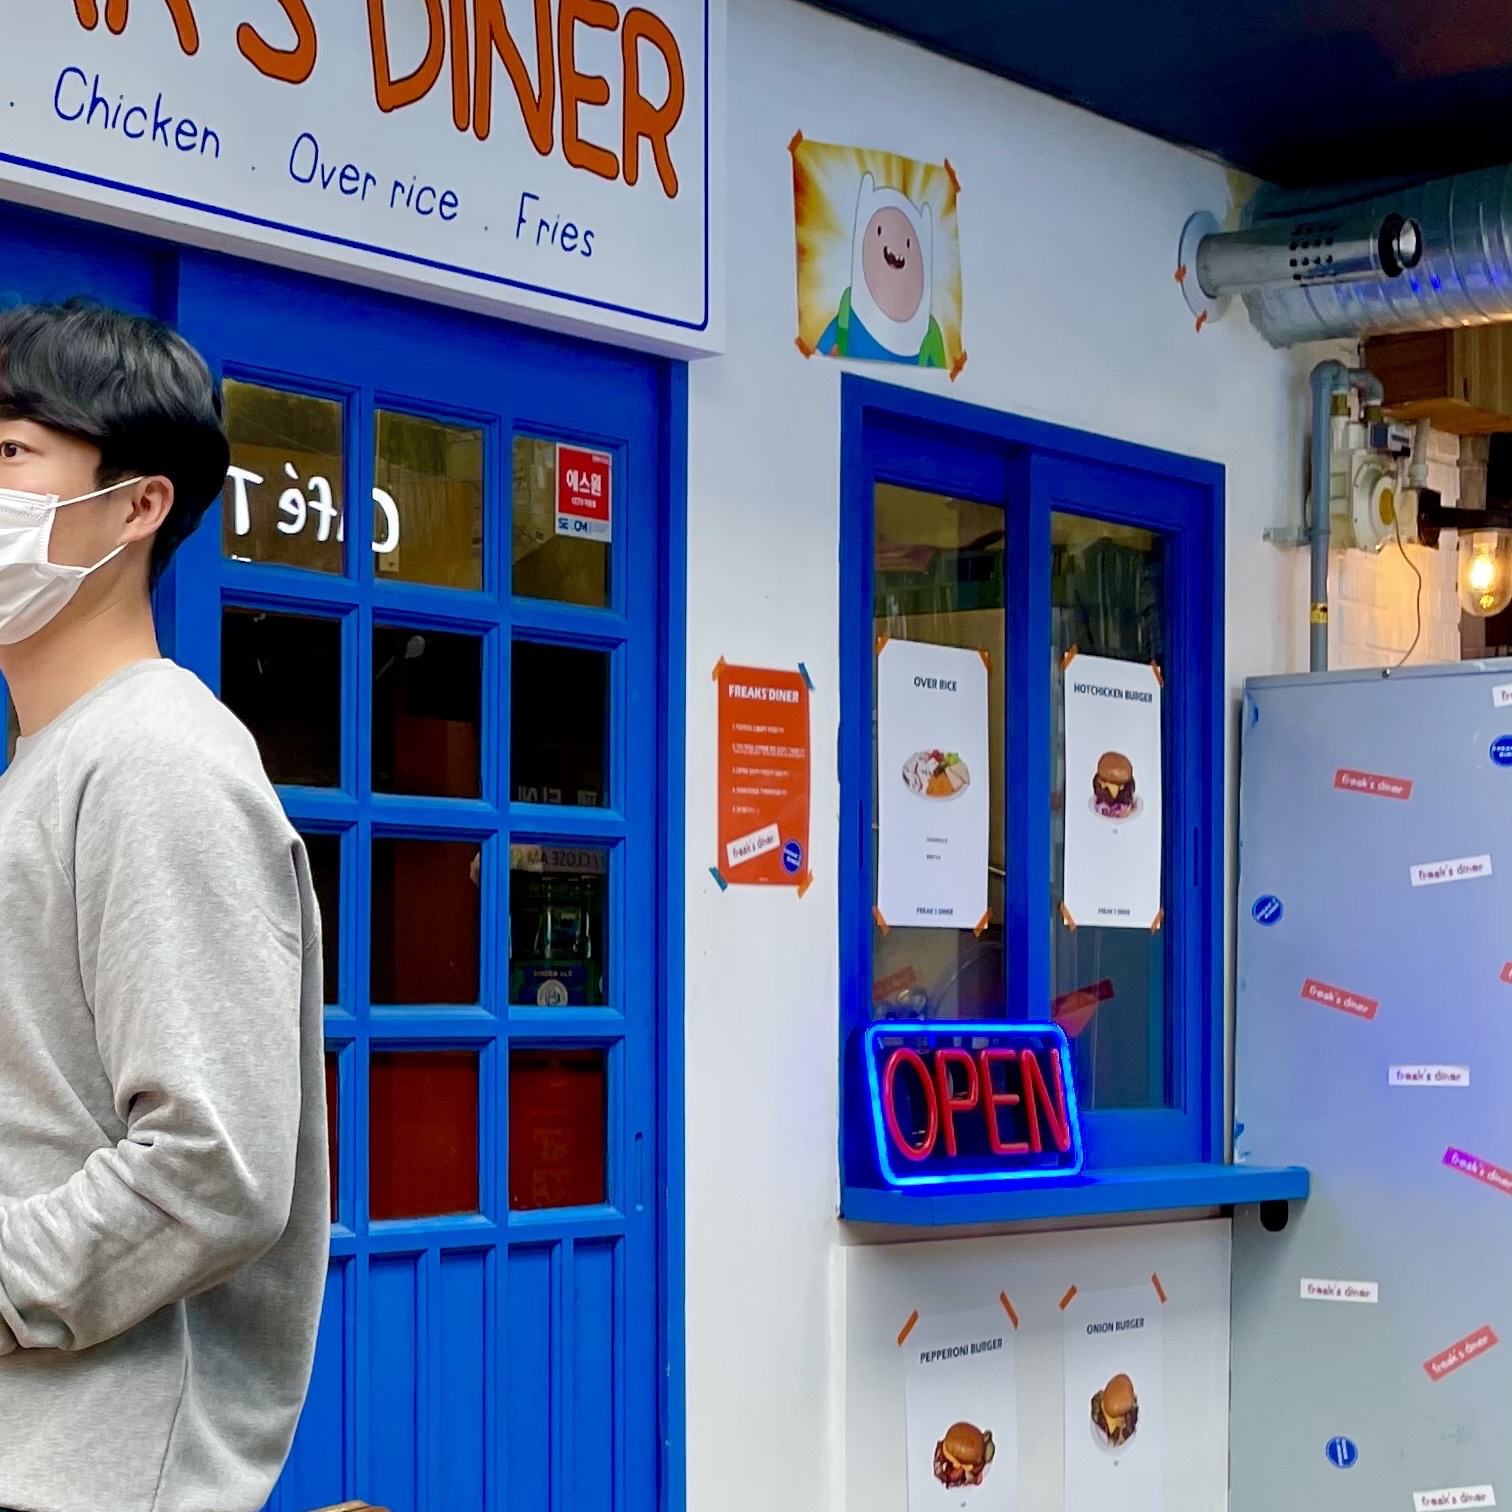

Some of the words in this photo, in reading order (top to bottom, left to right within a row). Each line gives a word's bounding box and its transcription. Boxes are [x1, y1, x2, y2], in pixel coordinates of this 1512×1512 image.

[367, 0, 684, 199] DINER
[54, 66, 221, 159] Chicken
[289, 132, 377, 201] Over
[390, 175, 459, 221] rice
[515, 191, 595, 258] Fries
[769, 687, 800, 704] DINER
[913, 675, 938, 689] OVER
[939, 678, 957, 692] RICE
[883, 1047, 1072, 1162] OPEN
[1086, 1321, 1114, 1335] ONION
[1115, 1317, 1146, 1332] BURGER
[920, 1344, 970, 1364] PEPPERONI
[970, 1337, 1004, 1355] BURGER
